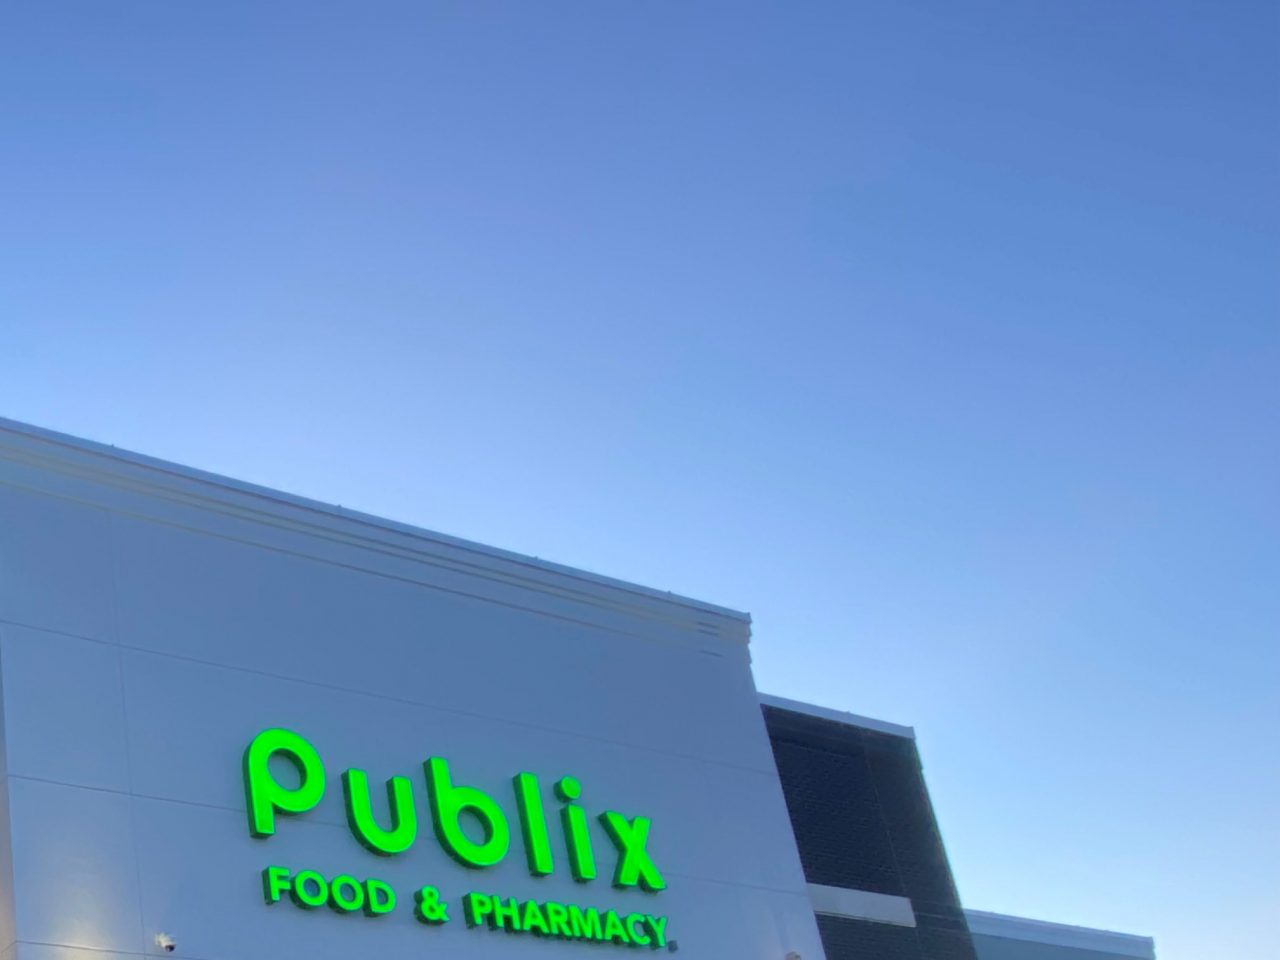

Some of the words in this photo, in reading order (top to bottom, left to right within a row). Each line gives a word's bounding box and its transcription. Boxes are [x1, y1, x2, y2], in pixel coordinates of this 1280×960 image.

[243, 727, 666, 893] Publix
[262, 866, 396, 917] FOOD
[415, 885, 449, 925] &
[463, 891, 667, 948] PHARMACY
